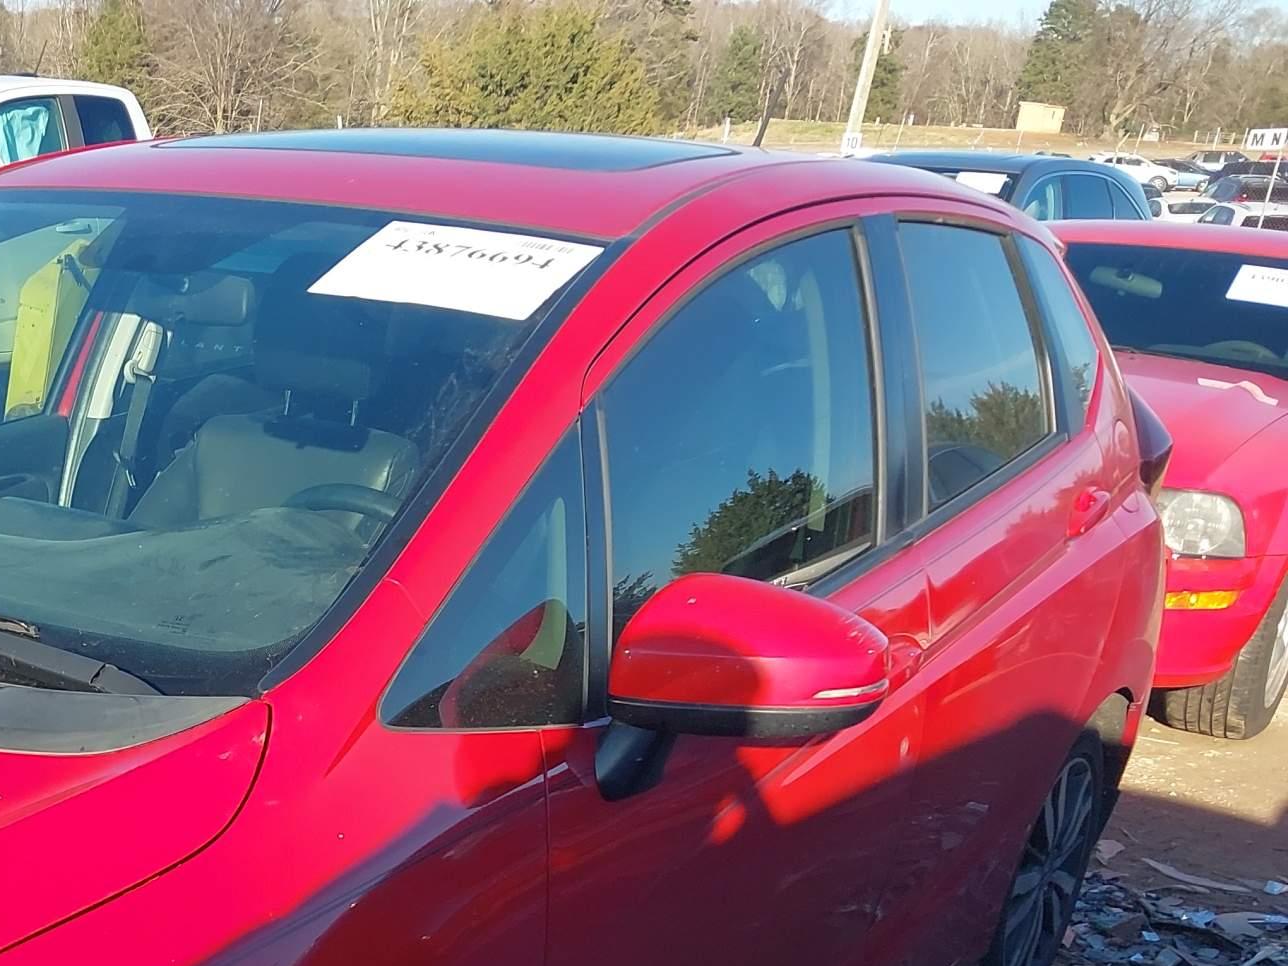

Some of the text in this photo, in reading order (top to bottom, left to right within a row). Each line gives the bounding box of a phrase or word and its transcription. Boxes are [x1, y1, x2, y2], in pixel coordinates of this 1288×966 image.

[846, 136, 858, 149] 10
[1251, 132, 1282, 147] M N
[385, 238, 556, 269] 43876694
